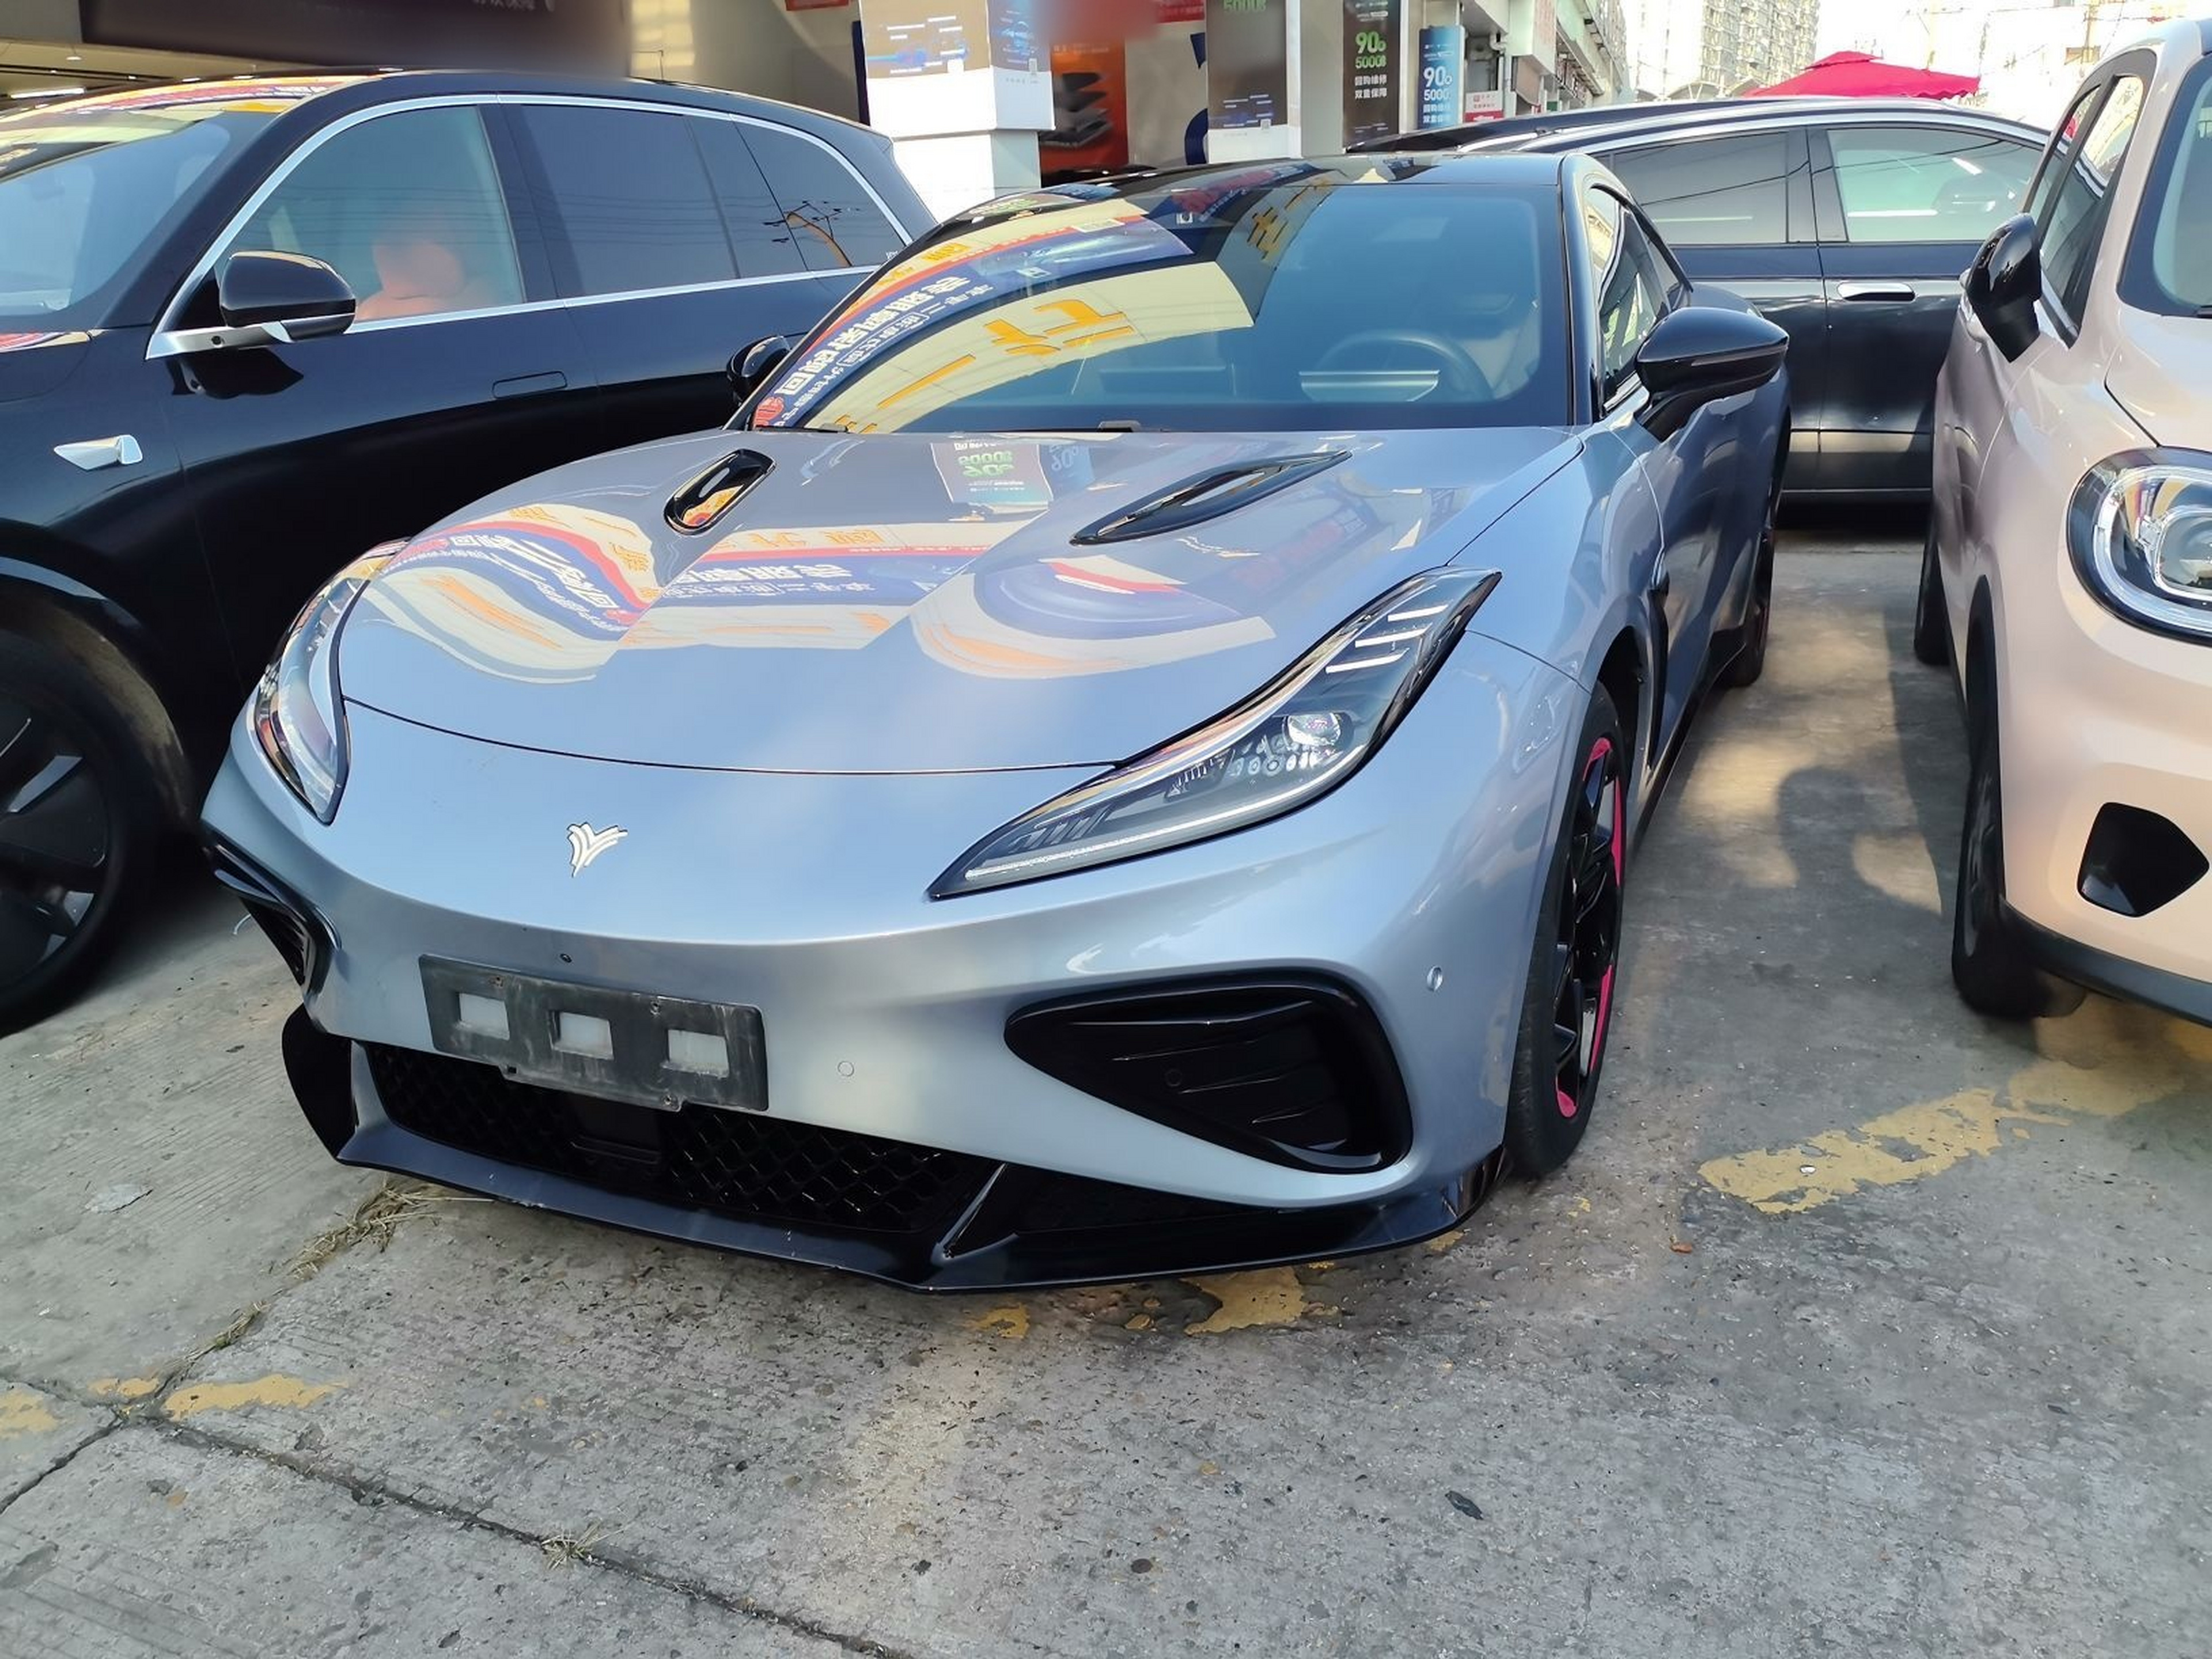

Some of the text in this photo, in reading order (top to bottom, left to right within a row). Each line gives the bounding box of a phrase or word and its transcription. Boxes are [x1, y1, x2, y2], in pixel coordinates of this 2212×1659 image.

[1424, 89, 1451, 101] 5000
[1423, 115, 1450, 124] 双重保
